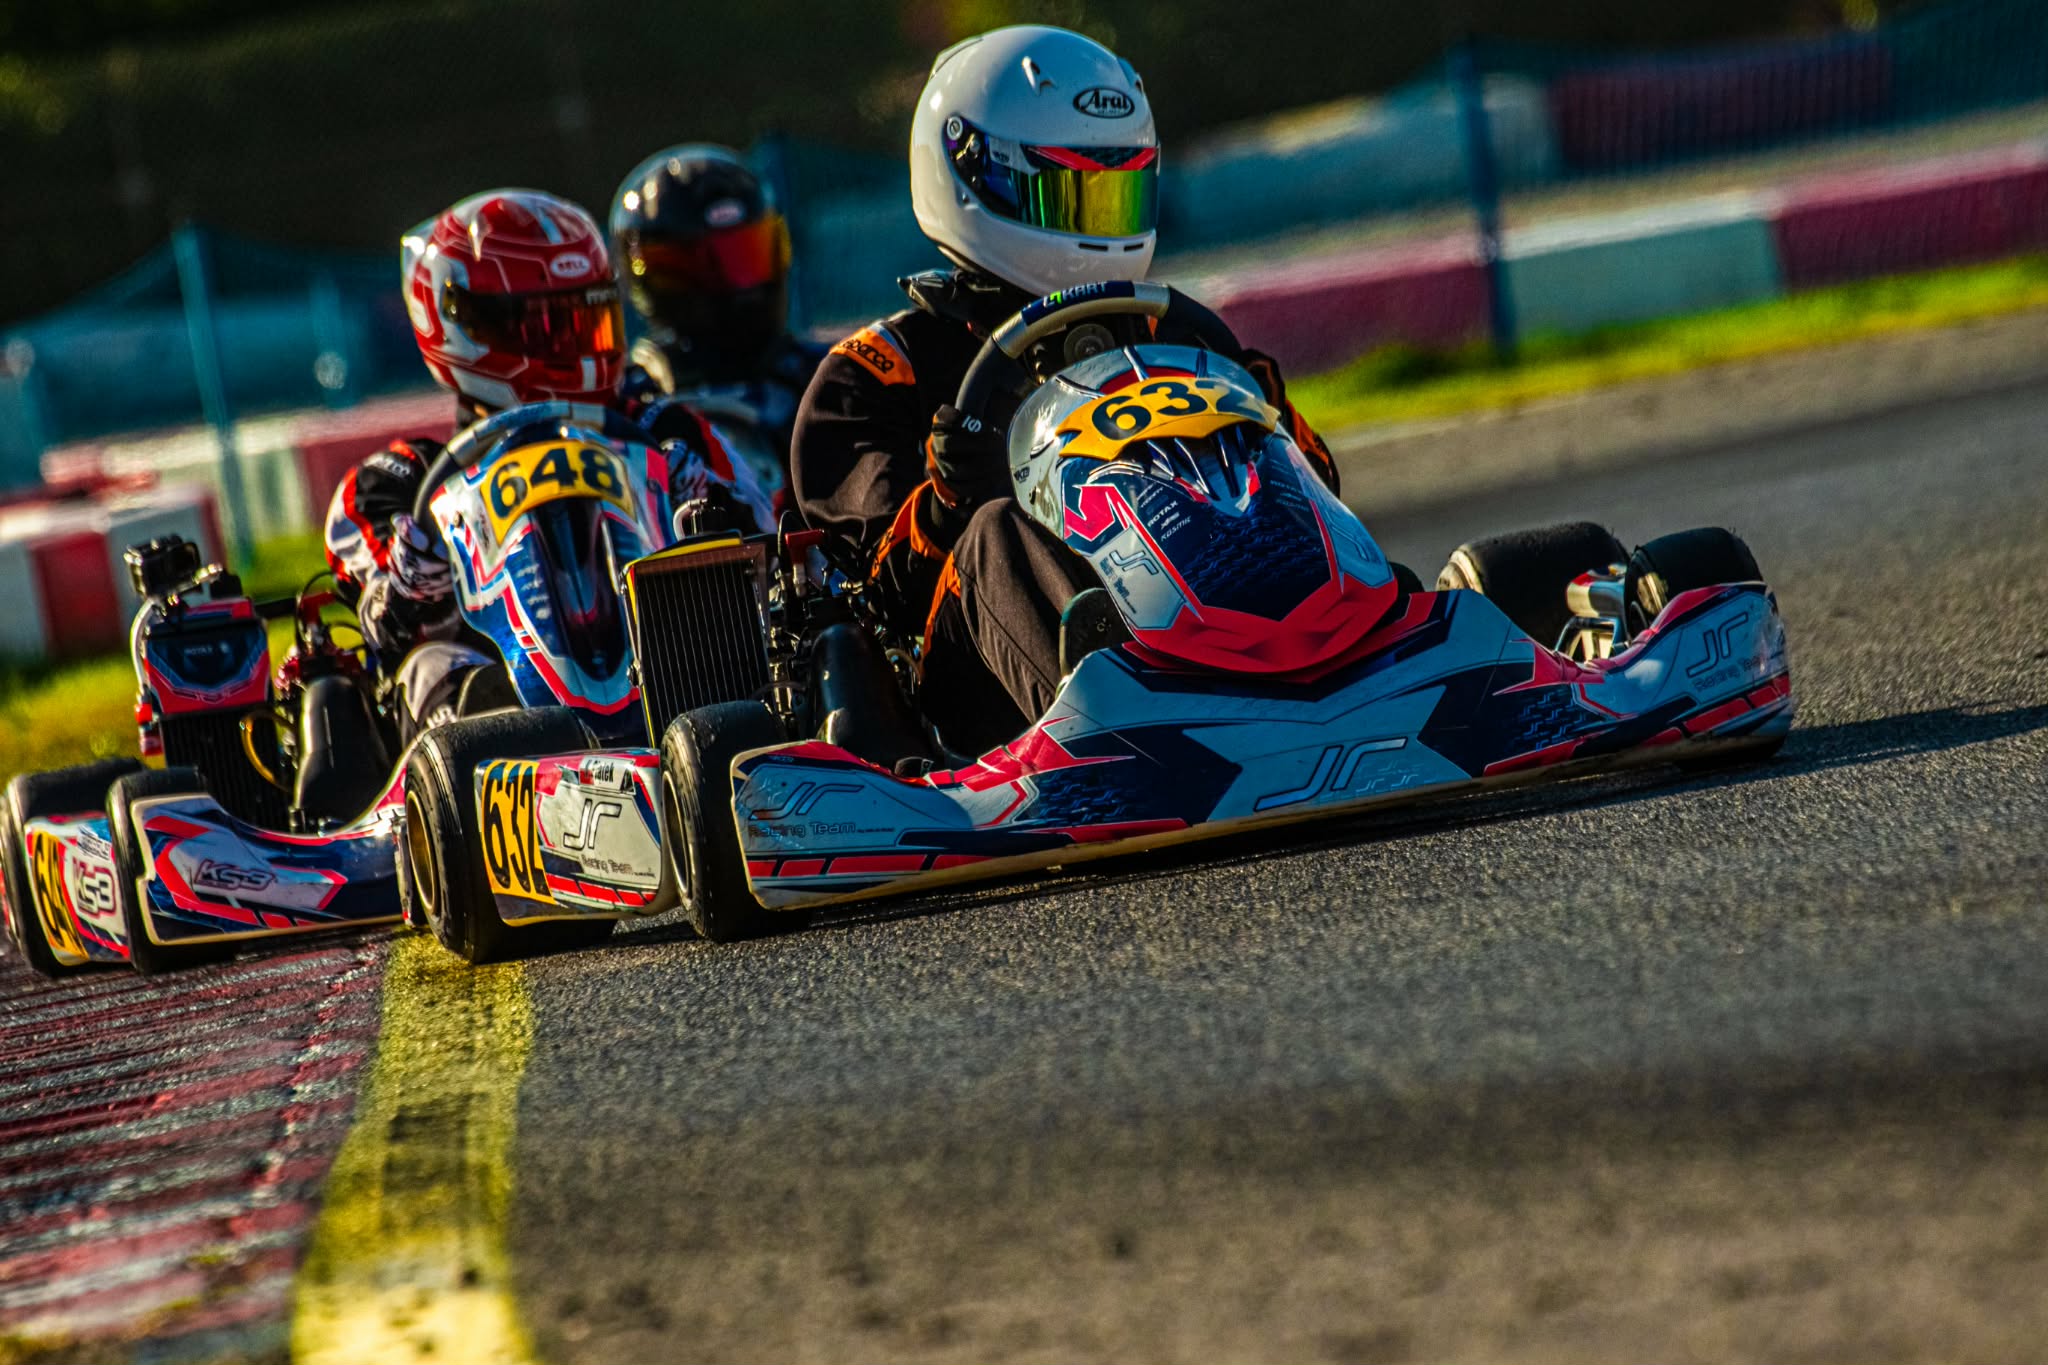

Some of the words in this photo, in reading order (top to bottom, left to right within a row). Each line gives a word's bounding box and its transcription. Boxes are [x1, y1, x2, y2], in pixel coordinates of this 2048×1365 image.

[1079, 88, 1129, 111] Arai
[1091, 381, 1261, 440] 632
[490, 448, 624, 518] 648
[1147, 500, 1178, 527] ROTAX
[483, 762, 552, 897] 632
[810, 821, 856, 834] Team
